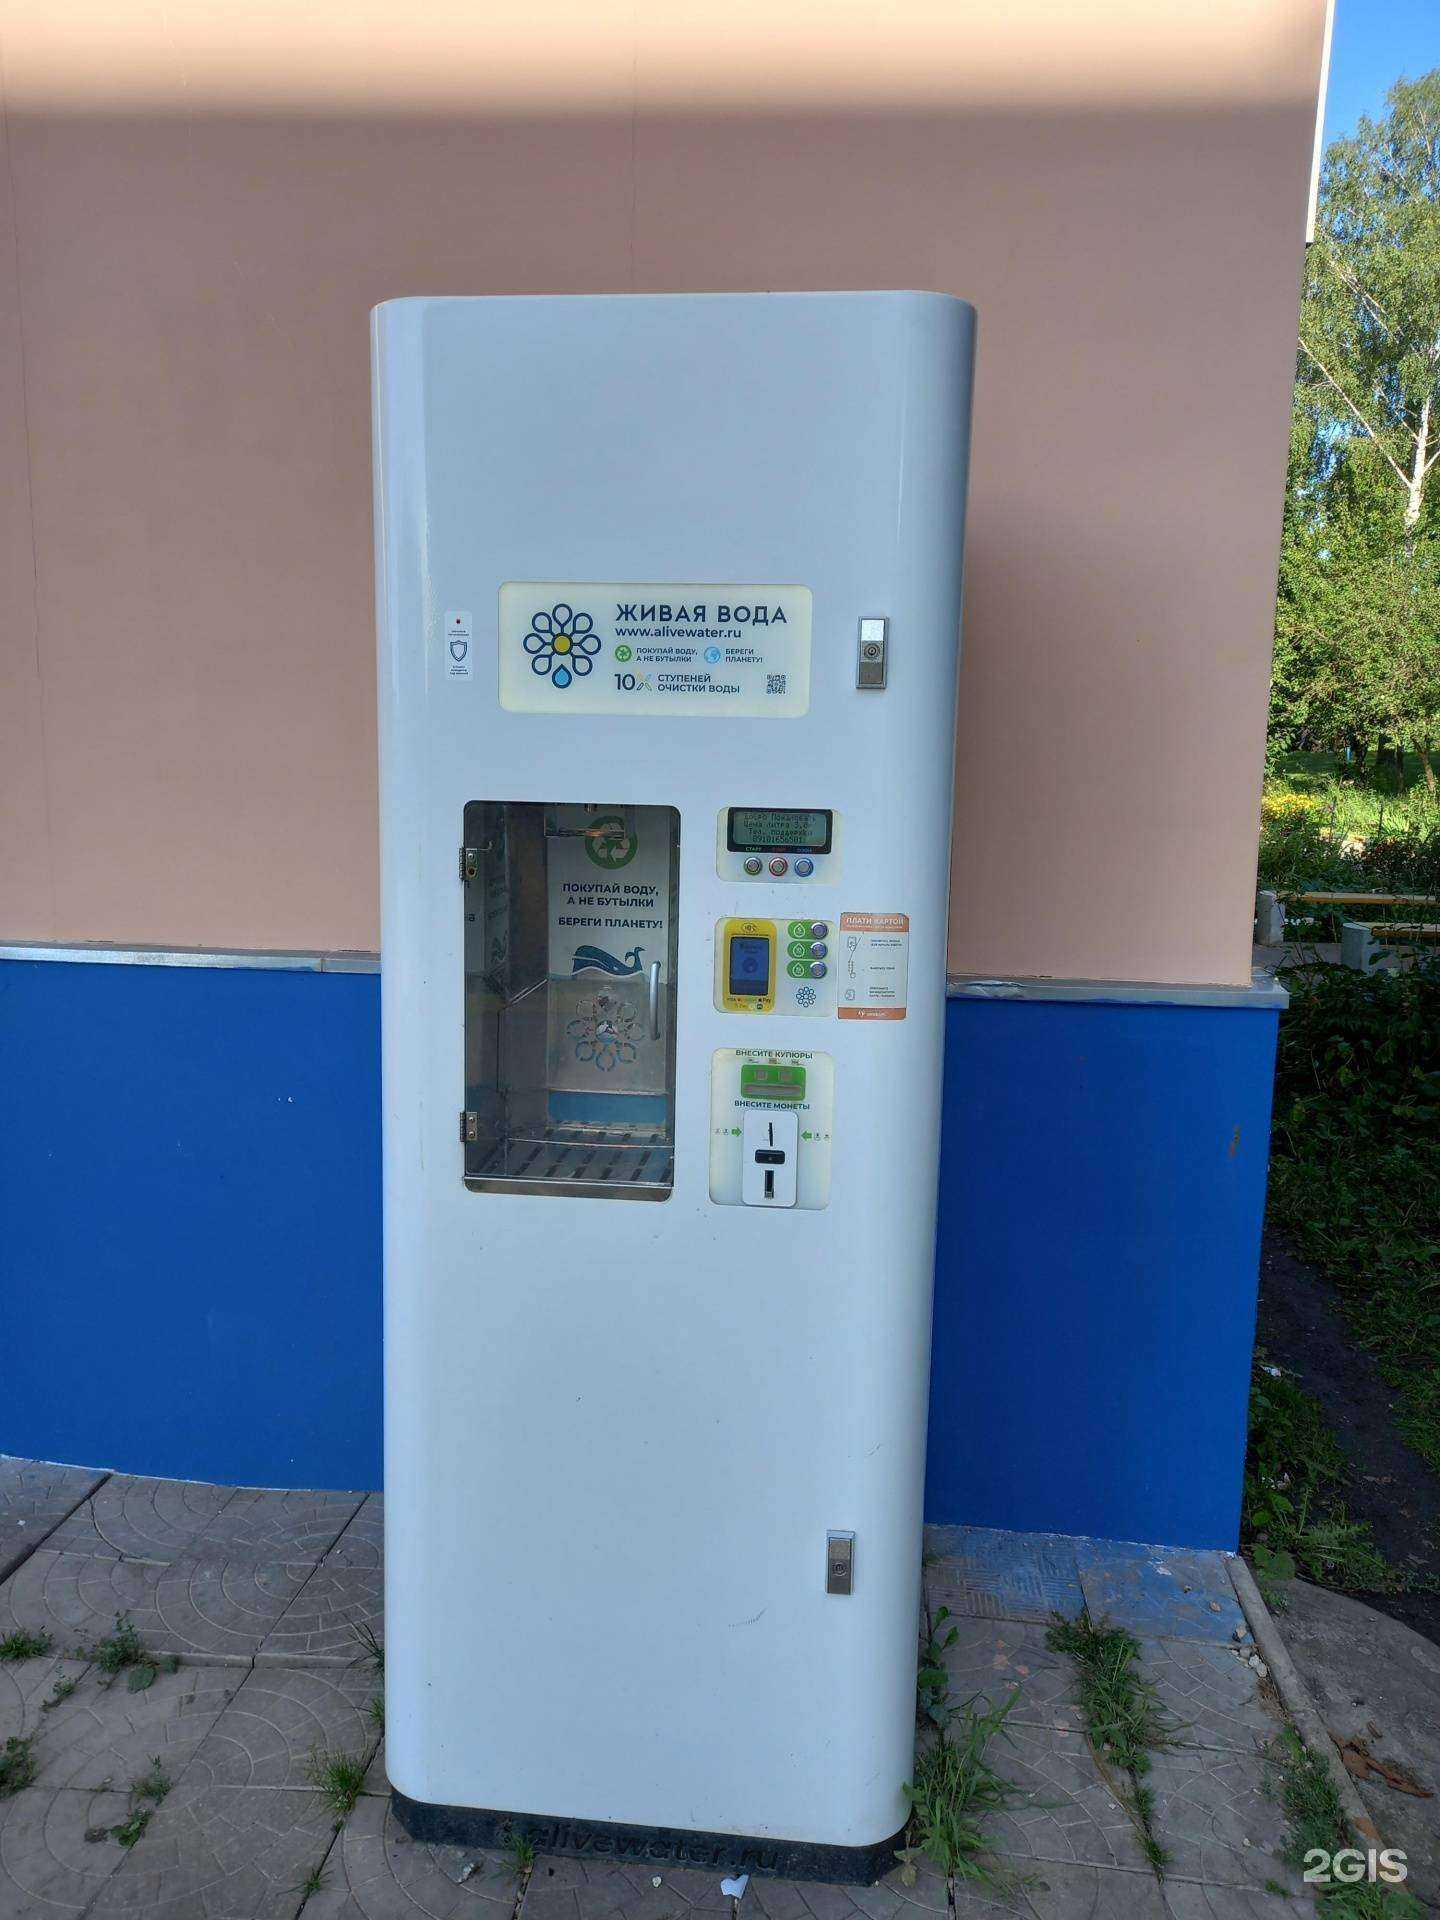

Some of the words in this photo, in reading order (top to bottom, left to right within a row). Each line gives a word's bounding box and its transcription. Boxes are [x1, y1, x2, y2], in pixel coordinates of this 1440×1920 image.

[615, 604, 706, 622] ЖИВАЯ
[717, 605, 787, 626] ВОДА
[615, 626, 742, 638] www.alivewater.ru
[636, 647, 674, 655] ПОКУПАЙ
[675, 648, 698, 656] ВОДУ,
[655, 655, 692, 663] БУТЫЛКИ
[614, 674, 636, 691] 10
[657, 672, 711, 683] СТУПЕНЕЙ
[657, 683, 706, 693] ОЧИСТКИ
[708, 684, 740, 694] ВОДЫ
[562, 883, 621, 893] ПОКУПАЙ
[623, 885, 659, 896] ВОДУ,
[567, 896, 575, 905] А
[579, 897, 594, 905] НЕ
[597, 898, 654, 907] БУТЫЛКИ
[558, 917, 602, 926] БЕРЕГИ
[605, 918, 663, 928] ПЛАНЕТУ!
[846, 917, 872, 925] ПЛАТИ
[735, 1049, 773, 1058] ВНЕСИТЕ
[775, 1051, 813, 1059] КУПЮРЫ
[734, 1100, 772, 1109] ВНЕСИТЕ
[773, 1102, 810, 1110] МОНЕТЫ
[528, 1822, 779, 1870] alivewater.ru
